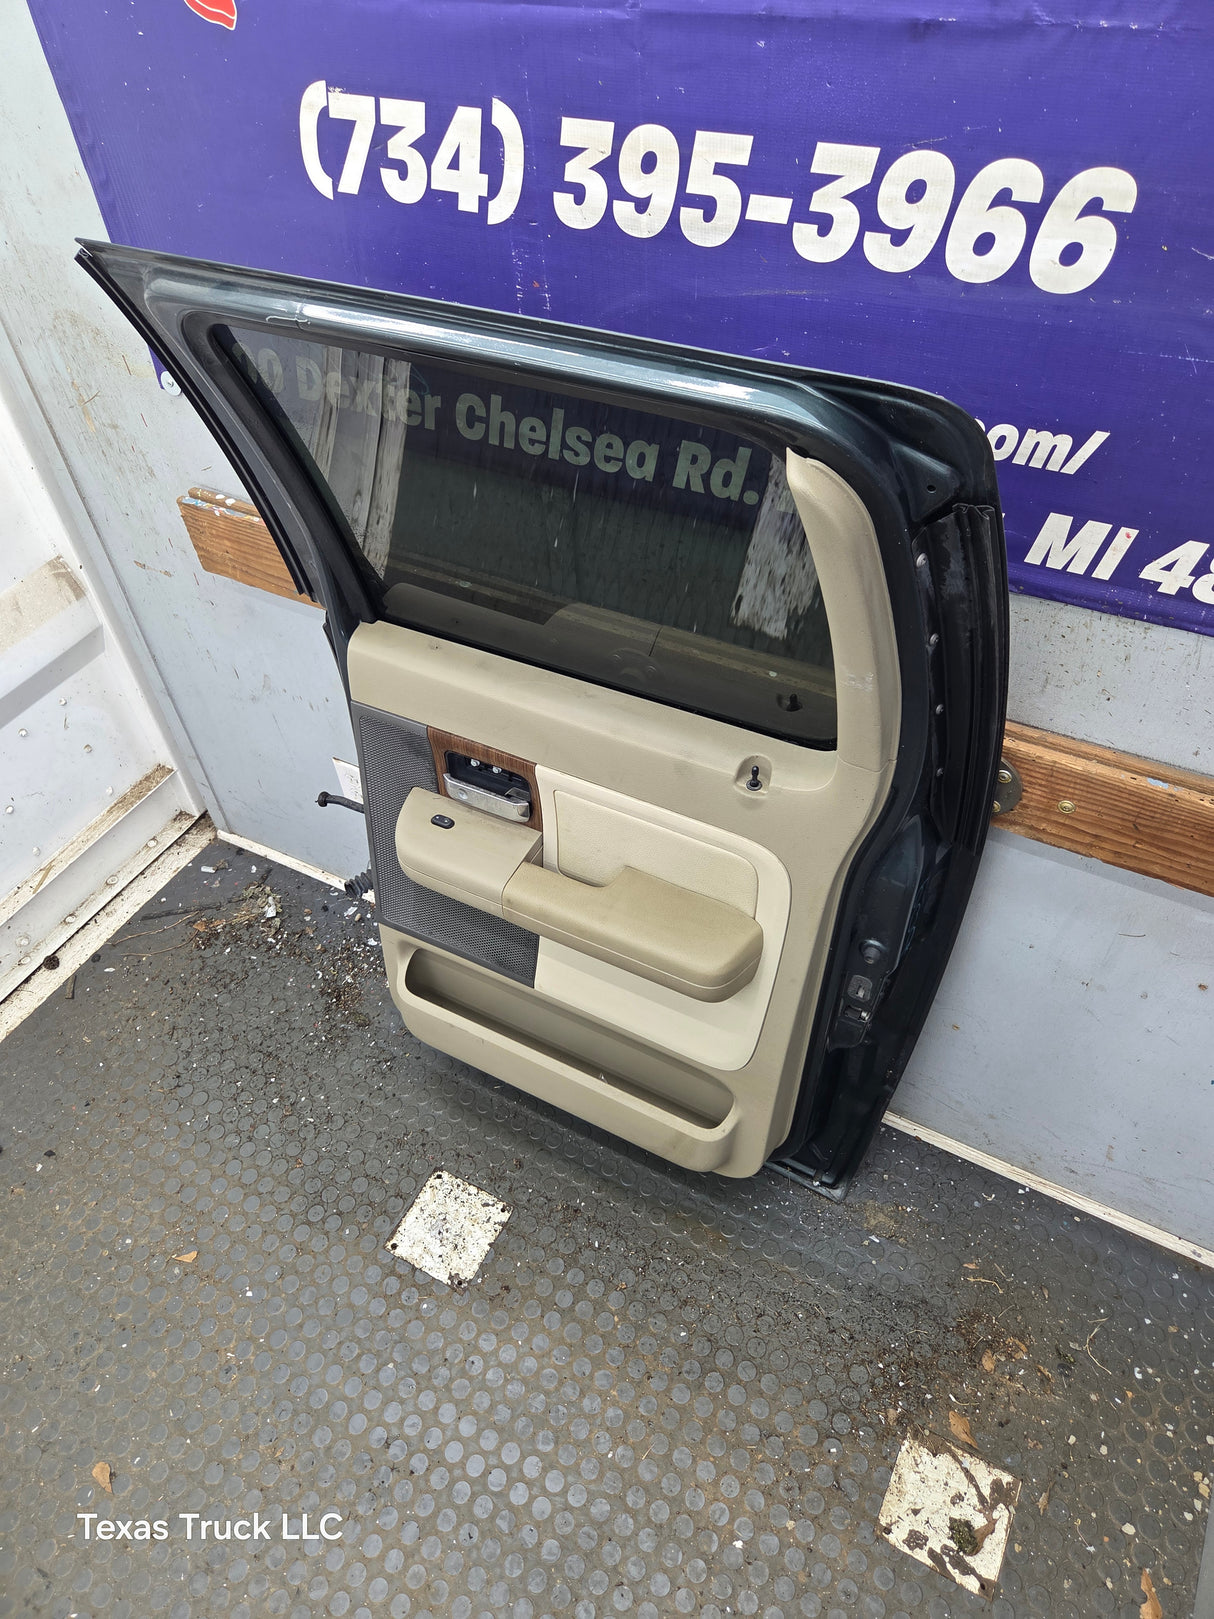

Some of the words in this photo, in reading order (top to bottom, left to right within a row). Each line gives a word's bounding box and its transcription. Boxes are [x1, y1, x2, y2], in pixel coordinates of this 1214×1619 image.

[299, 80, 525, 225] (734)
[553, 116, 1138, 295] 395-3966
[295, 354, 442, 431] Dexter
[455, 392, 660, 482] Chelsea
[672, 440, 760, 506] Rd.
[1023, 512, 1140, 581] MI
[974, 418, 1111, 475] om/
